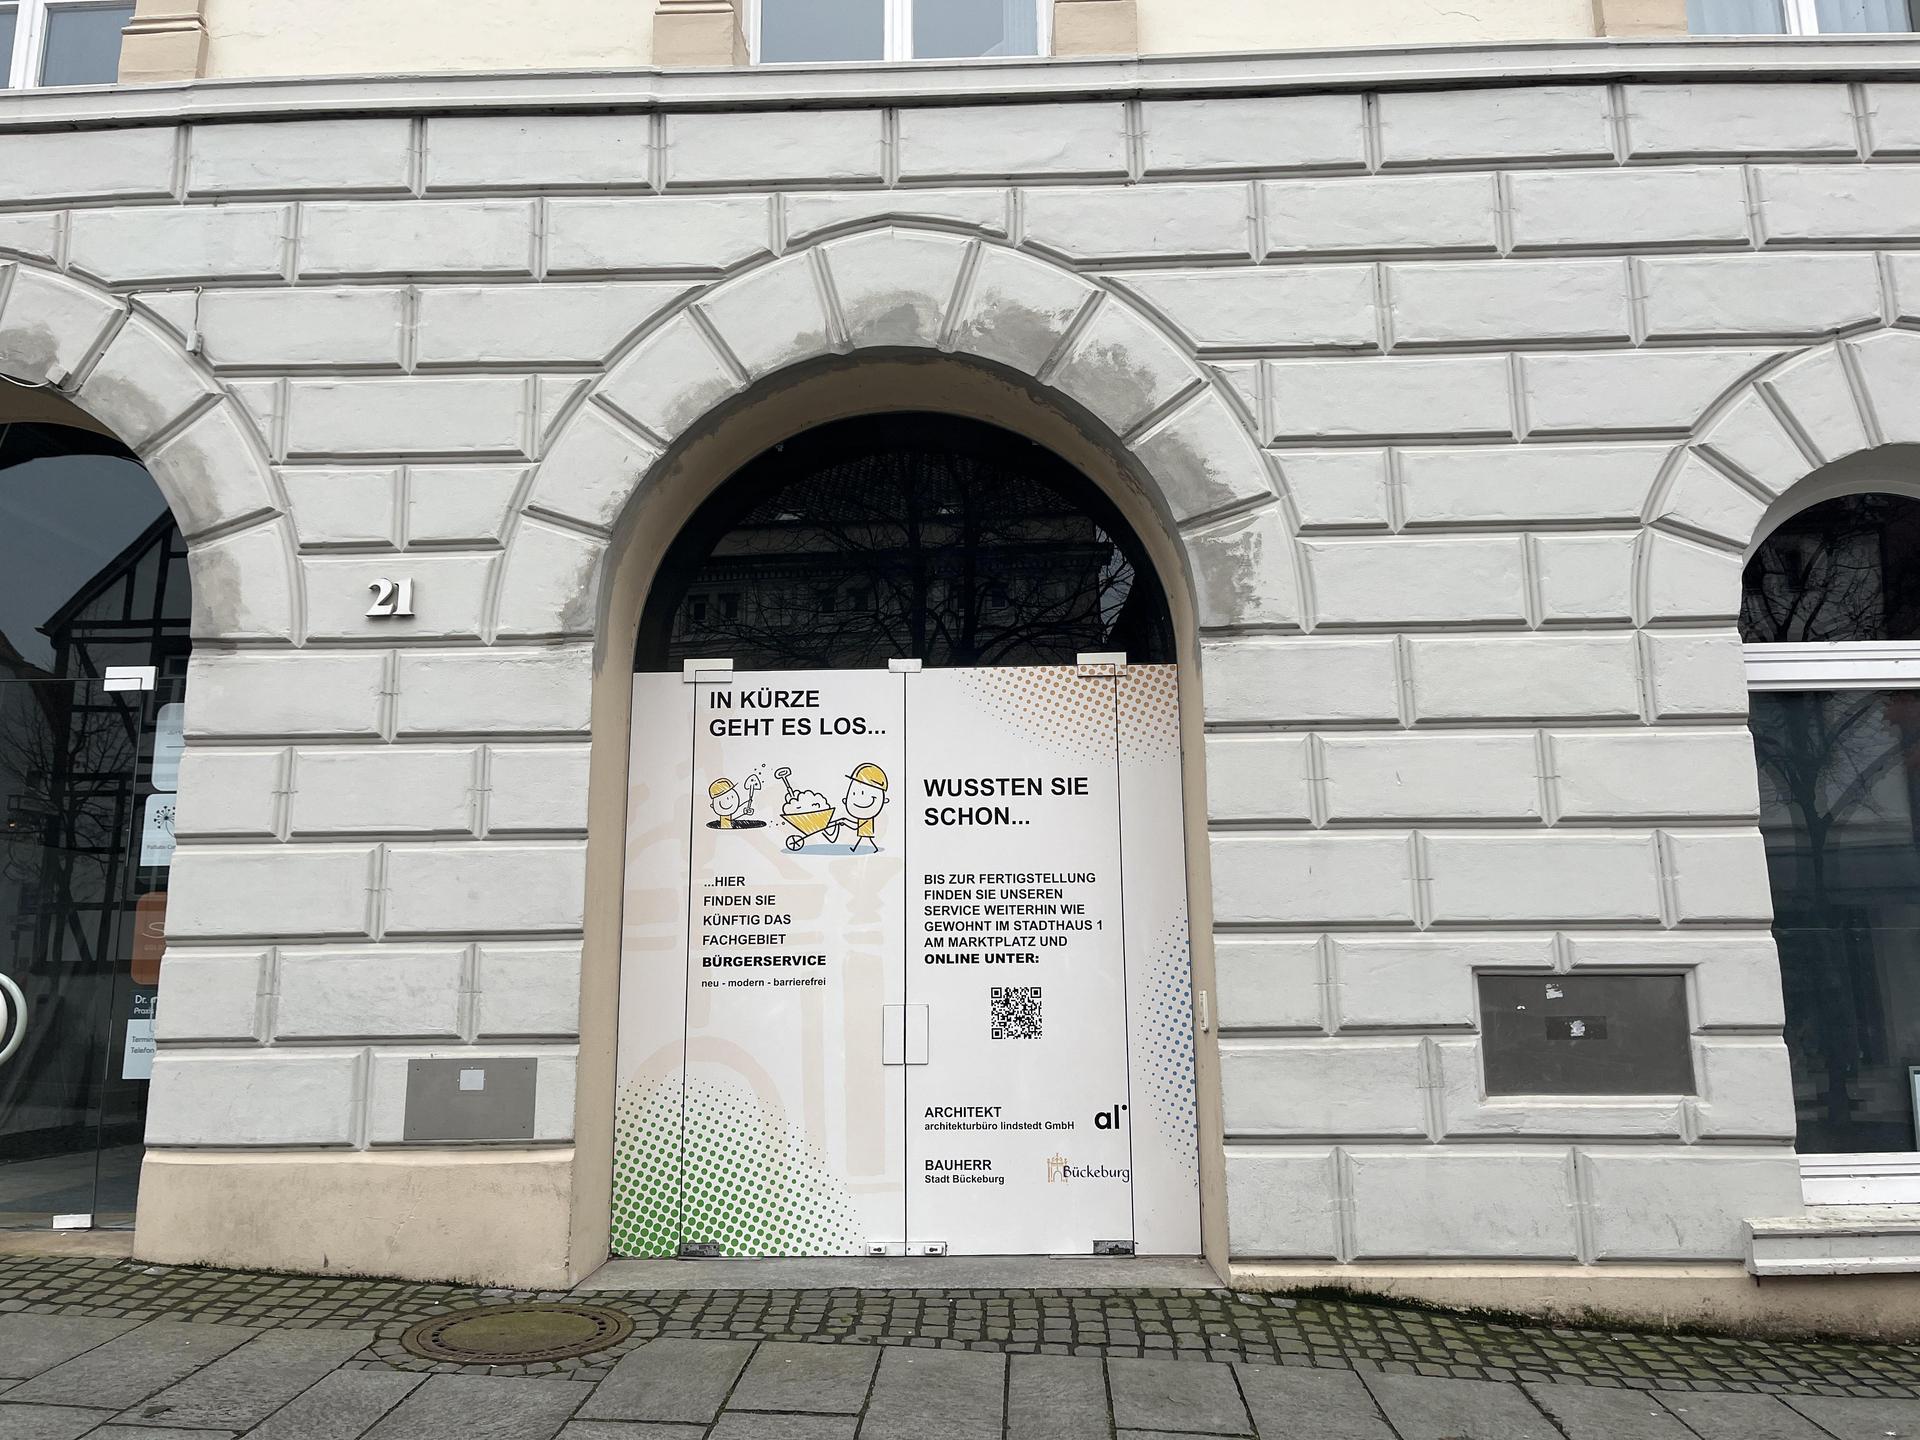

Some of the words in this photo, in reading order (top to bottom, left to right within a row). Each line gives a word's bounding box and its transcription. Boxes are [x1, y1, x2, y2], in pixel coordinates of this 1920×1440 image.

[365, 577, 414, 616] 21
[710, 691, 732, 708] IN
[740, 687, 820, 708] KÜRZE
[709, 718, 774, 736] GEHT
[782, 718, 812, 736] ES
[820, 717, 886, 735] LOS...
[924, 777, 1043, 797] WUSSTEN
[1050, 777, 1089, 796] SIE
[924, 806, 1030, 826] SCHON...
[704, 876, 746, 887] ...HIER
[924, 874, 945, 885] BIS
[949, 873, 976, 885] ZUR
[979, 872, 1096, 884] FERTIGSTELLUNG
[924, 889, 972, 900] FINDEN
[975, 889, 997, 900] SIE
[1000, 888, 1064, 900] UNSEREN
[703, 895, 752, 907] FINDEN
[755, 895, 776, 906] SIE
[924, 905, 981, 916] SERVICE
[984, 904, 1057, 916] WEITERHIN
[1060, 904, 1085, 915] WIE
[703, 913, 761, 926] KÜNFTIG
[764, 914, 792, 925] DAS
[924, 921, 992, 932] GEWOHNT
[995, 921, 1010, 931] IM
[1013, 919, 1093, 931] STADTHAUS
[1096, 919, 1104, 931] 1
[702, 933, 787, 946] FACHGEBIET
[924, 937, 944, 948] AM
[948, 936, 1037, 948] MARKTPLATZ
[1039, 936, 1068, 947] UND
[702, 954, 827, 968] BÜRGERSERVICE
[924, 953, 980, 965] ONLINE
[984, 952, 1040, 964] UNTER:
[701, 980, 719, 988] neu
[727, 978, 765, 987] modern
[773, 977, 827, 987] barrierefrei
[135, 994, 148, 1004] Dr.
[924, 1106, 1002, 1118] ARCHITEKT
[924, 1121, 998, 1131] architekturbüro
[1000, 1121, 1043, 1130] lindstedt
[1044, 1121, 1075, 1130] GmbH
[924, 1159, 992, 1171] BAUHERR
[924, 1174, 950, 1184] Stadt
[952, 1174, 1005, 1185] Bückeburg
[1062, 1164, 1130, 1183] Bückeburg
